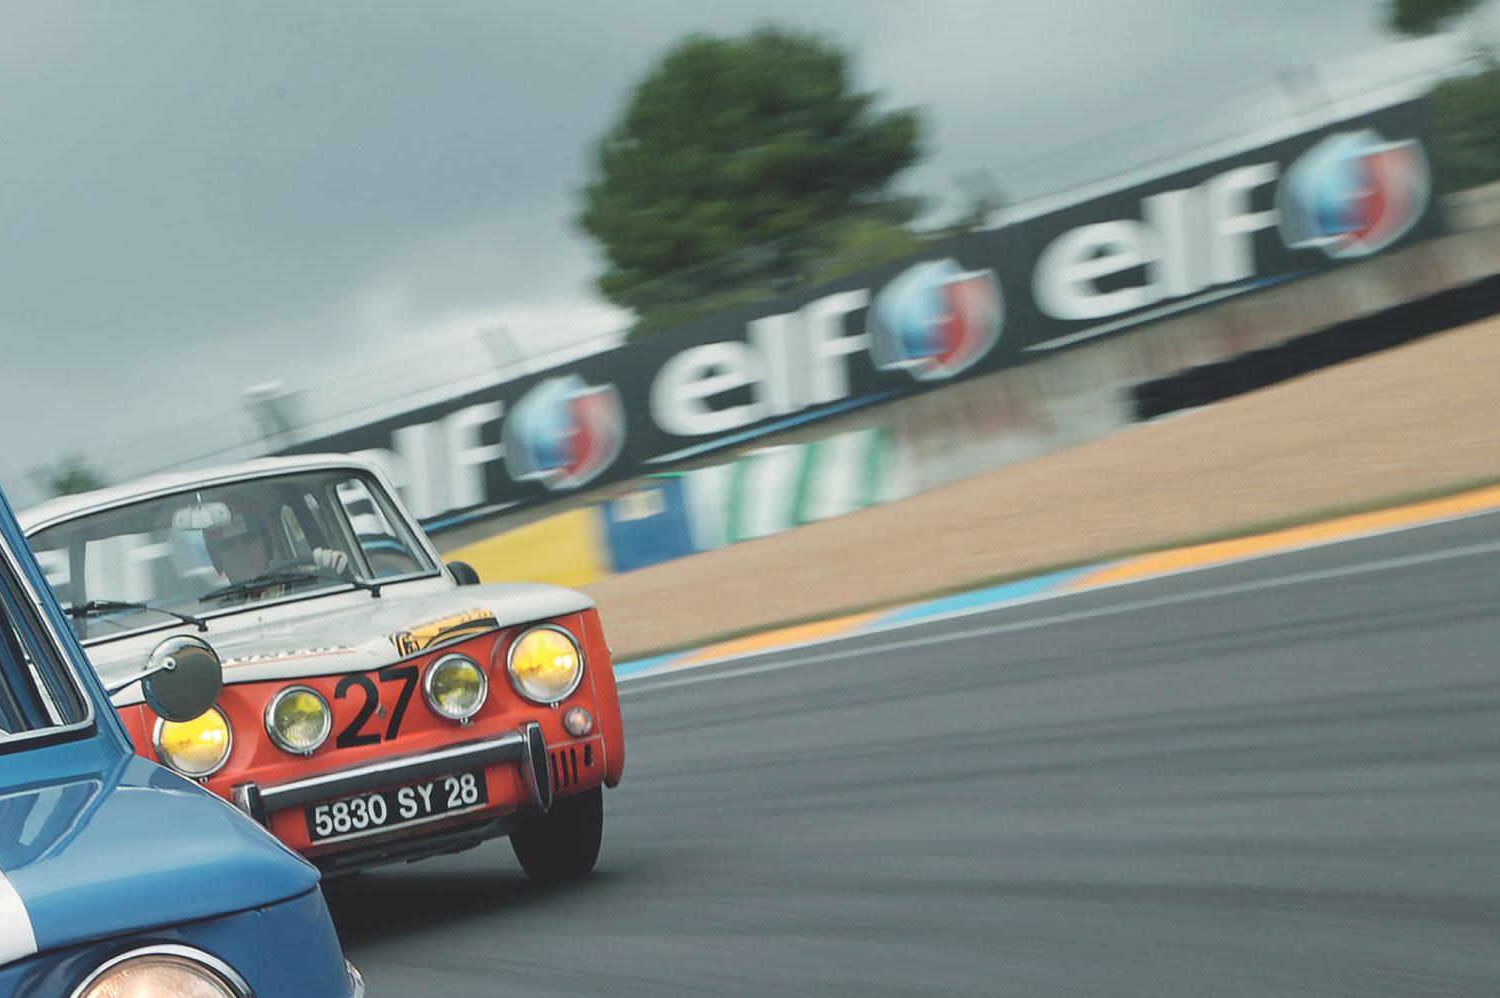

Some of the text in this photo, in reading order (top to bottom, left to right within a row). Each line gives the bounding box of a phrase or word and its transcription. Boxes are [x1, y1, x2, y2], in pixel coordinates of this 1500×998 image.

[1031, 160, 1280, 321] elf
[649, 288, 870, 437] elf
[334, 665, 419, 748] 27
[315, 773, 478, 836] 5830 SY 28
